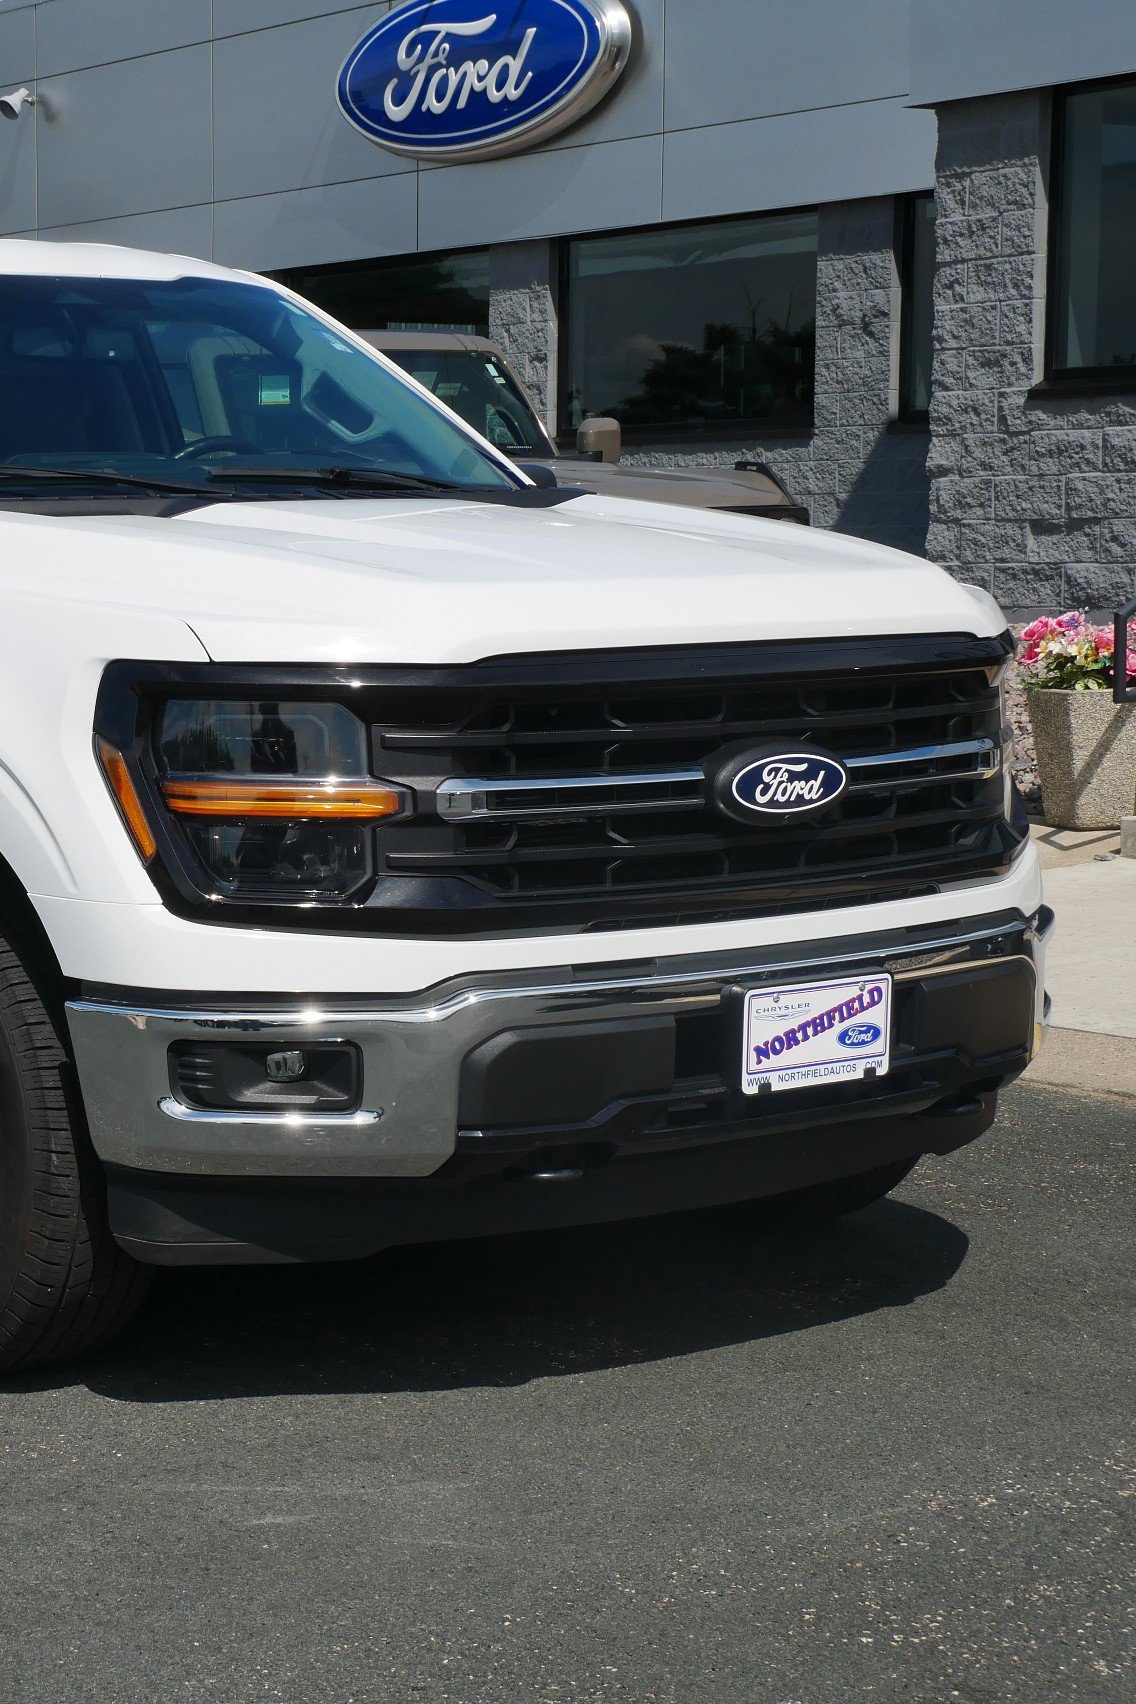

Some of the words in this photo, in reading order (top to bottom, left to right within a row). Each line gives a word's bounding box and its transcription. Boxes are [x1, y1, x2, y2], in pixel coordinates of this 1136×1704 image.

[383, 13, 537, 123] Ford
[755, 762, 826, 804] Ford
[752, 985, 884, 1066] NORTHFIELD
[755, 1002, 811, 1014] CHRYSLER
[845, 1026, 874, 1044] Ford
